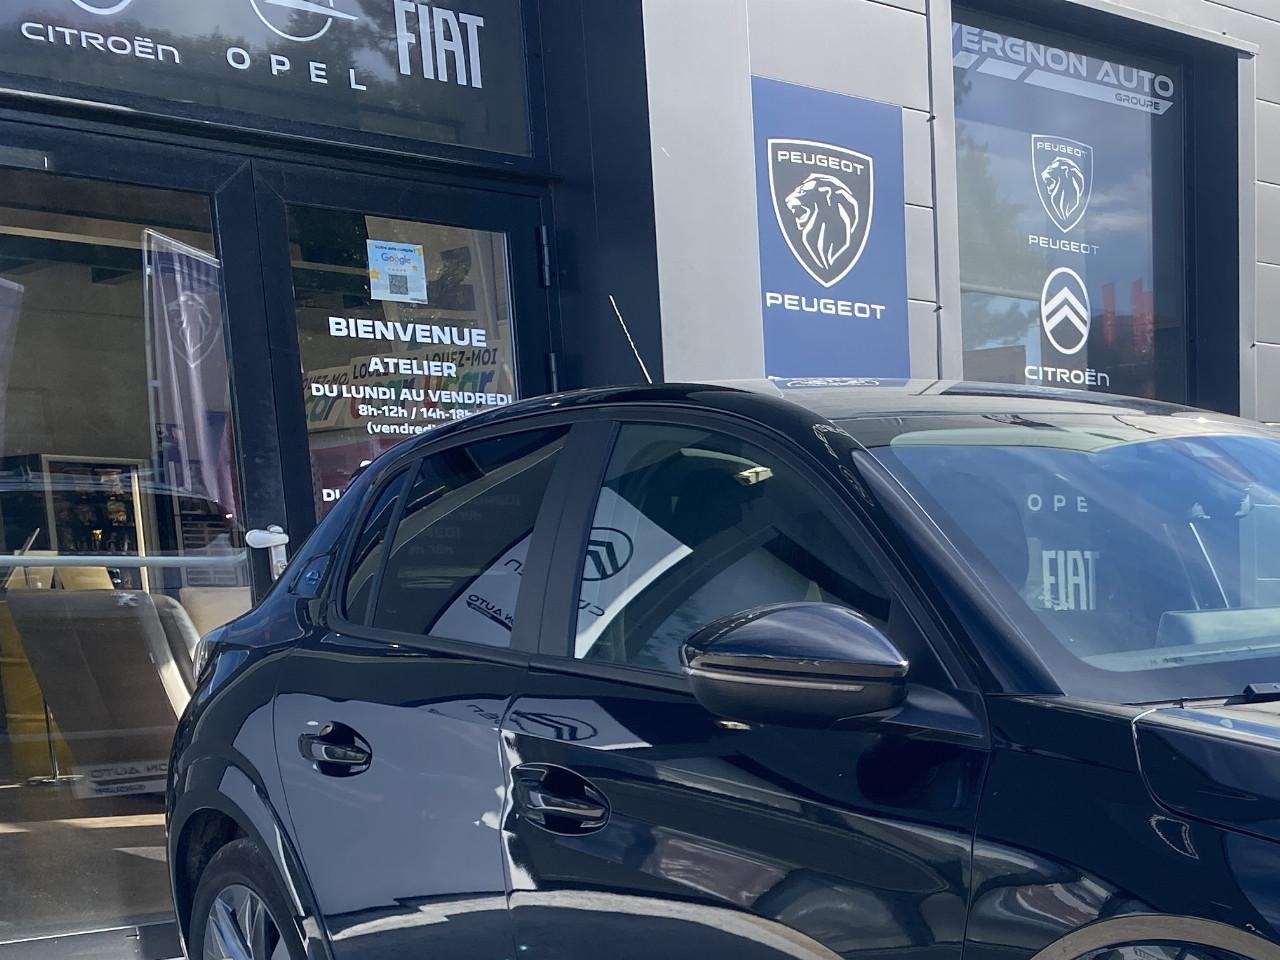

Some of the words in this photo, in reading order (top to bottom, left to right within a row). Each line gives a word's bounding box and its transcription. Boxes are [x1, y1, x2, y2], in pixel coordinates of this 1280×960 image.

[20, 22, 181, 64] CITROËN
[394, 0, 484, 89] FIAT
[226, 47, 367, 91] OPEL
[1096, 61, 1174, 97] AUTO
[1115, 92, 1161, 111] GROUPE
[1037, 141, 1087, 158] PEUGEOT
[777, 150, 864, 175] PEUGEOT
[1029, 235, 1099, 254] PEUGEOT
[381, 252, 411, 265] Google
[765, 292, 886, 319] PEUGEOT
[328, 316, 487, 347] BIENVENUE
[369, 356, 457, 378] ATELIER
[1024, 365, 1110, 387] CITROËN
[311, 383, 338, 397] DU
[341, 385, 396, 400] LUNDI
[399, 388, 425, 402] AU
[428, 389, 512, 405] VENDREDI
[358, 404, 408, 418] 8h-12h
[1042, 550, 1100, 610] FIAT
